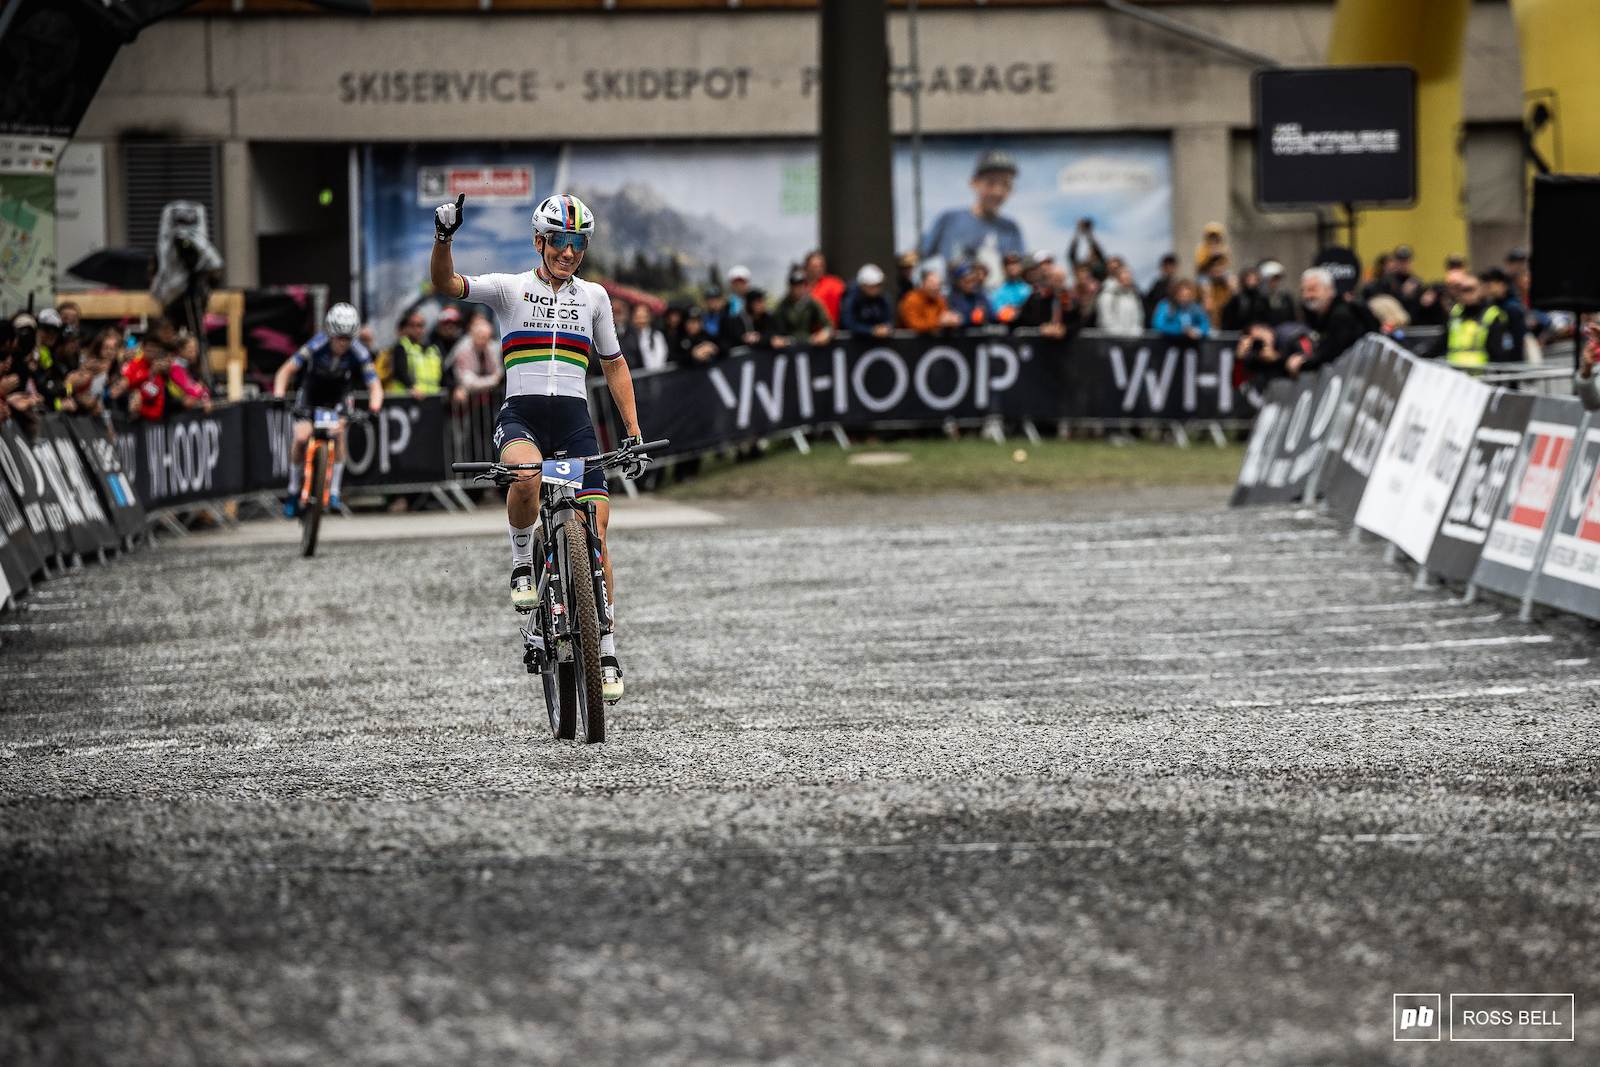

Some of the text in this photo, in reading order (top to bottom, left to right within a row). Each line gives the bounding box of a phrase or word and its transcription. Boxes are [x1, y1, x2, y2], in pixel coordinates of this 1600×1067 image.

[338, 69, 540, 104] SKISERVICE
[582, 67, 750, 102] SKIDEPOT
[529, 293, 554, 306] UCI
[532, 306, 579, 320] INEOS
[523, 321, 586, 332] GRENADIER
[708, 344, 1019, 429] WHOOP
[266, 406, 412, 478] WOP
[555, 461, 571, 475] 3
